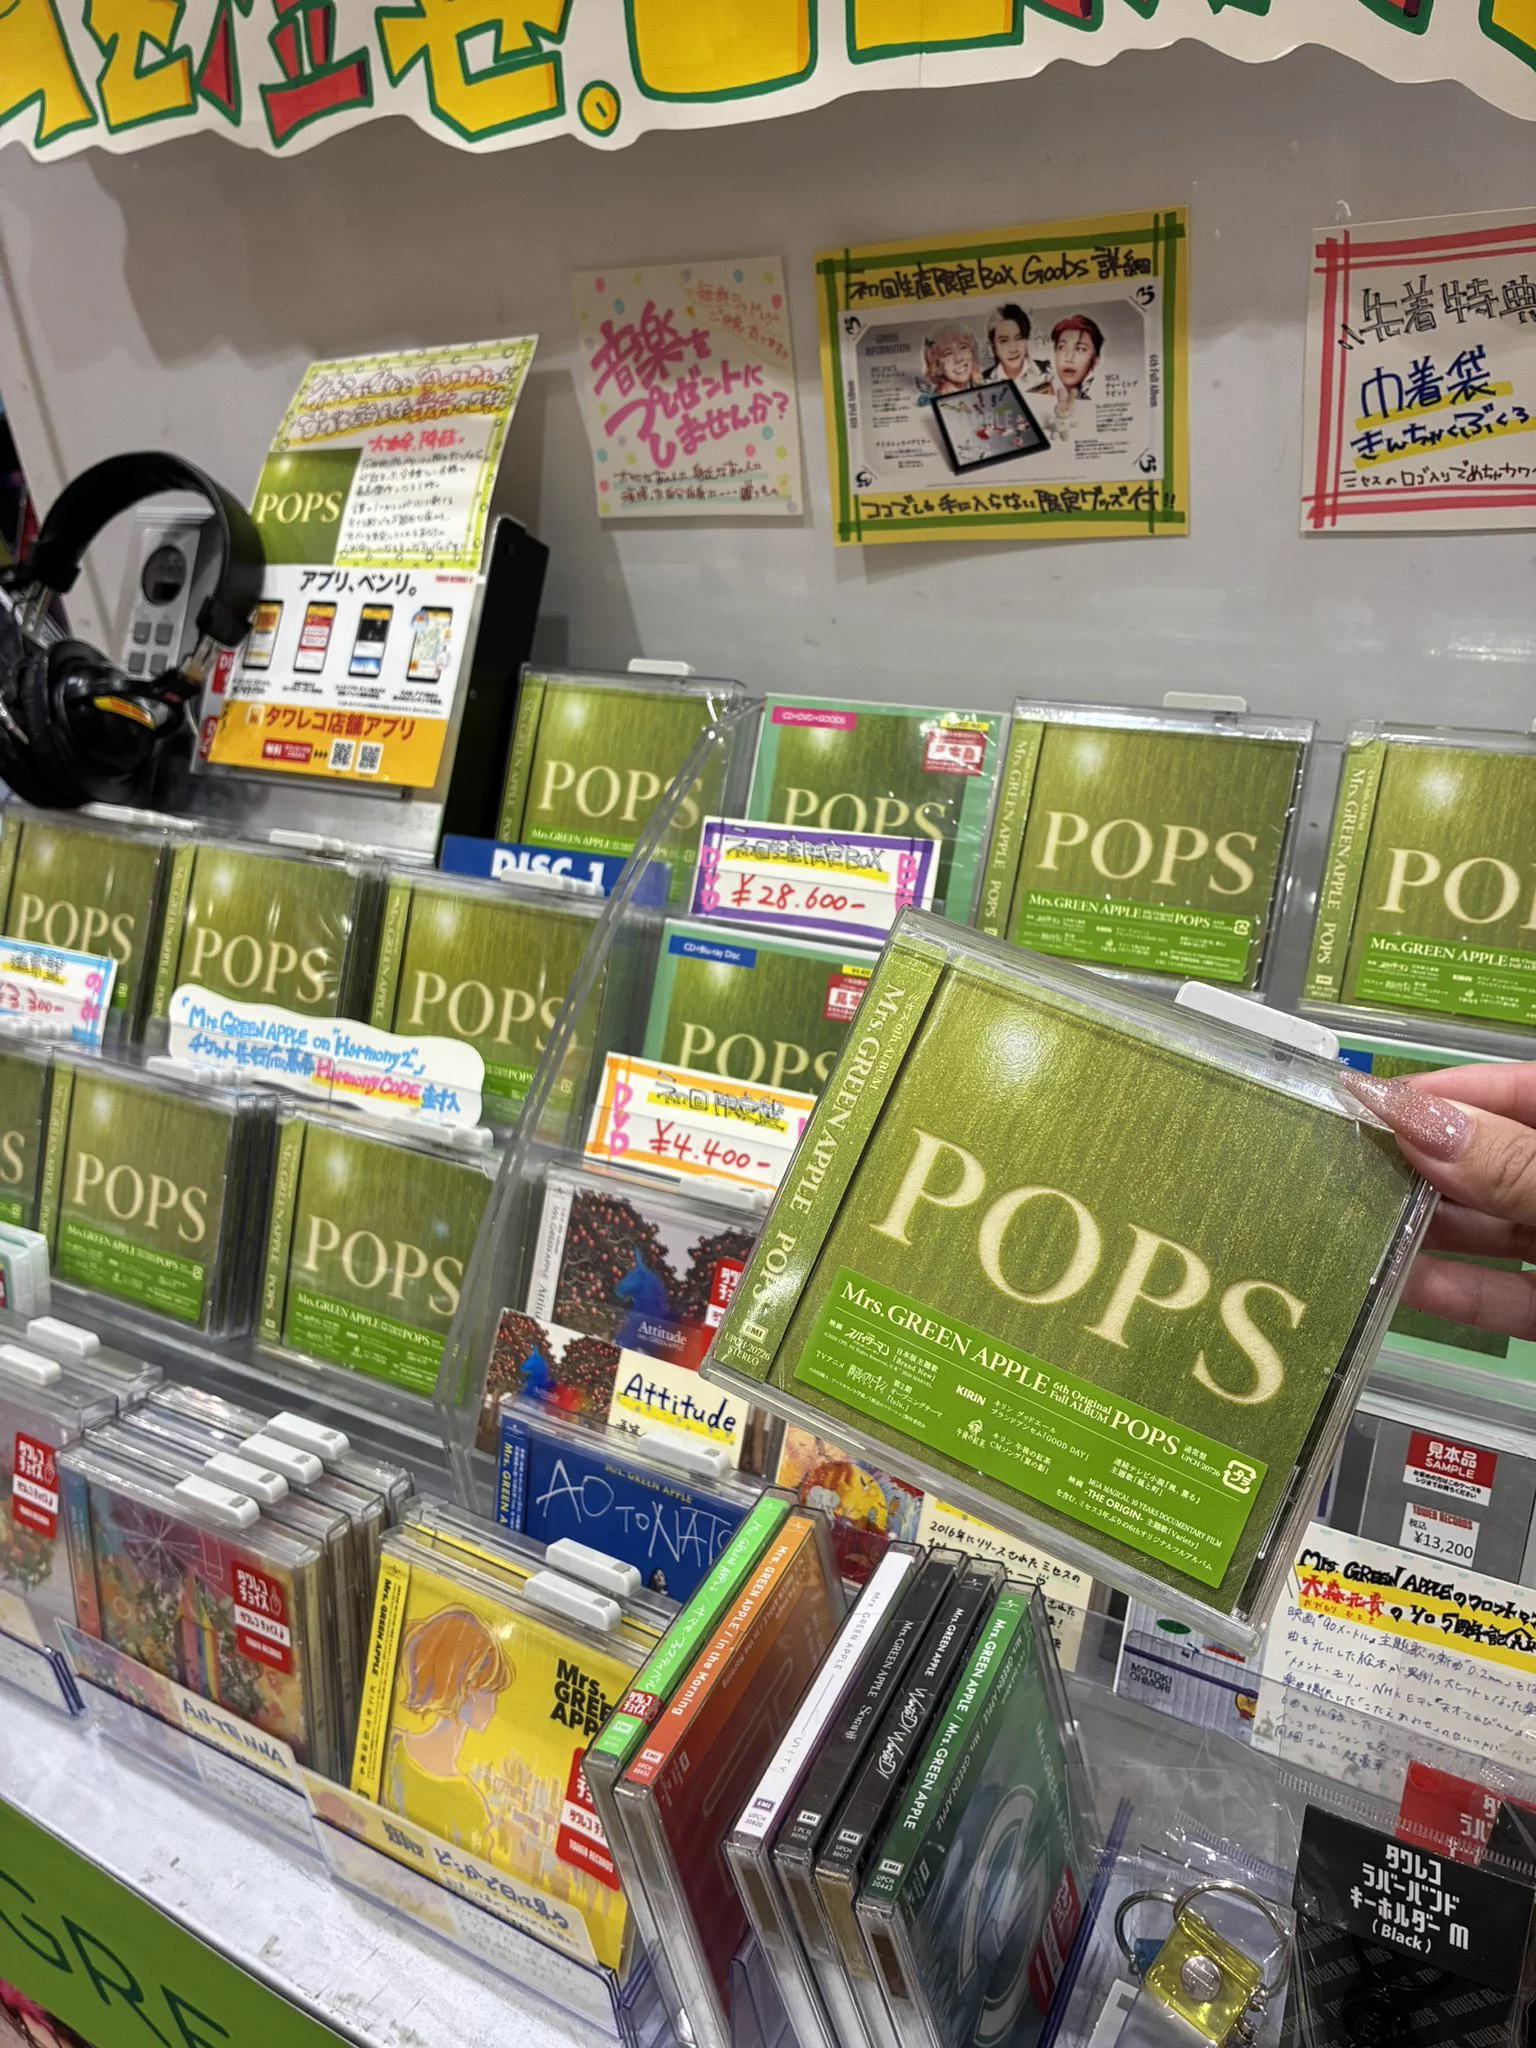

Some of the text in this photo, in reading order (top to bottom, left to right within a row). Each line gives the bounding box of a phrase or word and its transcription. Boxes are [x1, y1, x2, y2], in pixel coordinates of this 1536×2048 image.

[845, 262, 977, 301] 初回生産限定
[1021, 252, 1089, 287] Goods
[1359, 273, 1536, 343] 先着特典
[590, 299, 712, 397] 音楽を
[604, 360, 764, 441] プレゼントに
[1361, 344, 1497, 419] 巾着袋
[255, 490, 343, 525] POPS
[299, 569, 418, 597] アプリ、ベンリ。
[265, 704, 417, 740] タワレコ店舗アプリ
[538, 758, 704, 830] POPS
[783, 786, 949, 841] POPS
[1036, 810, 1259, 896] POPS
[985, 880, 1002, 919] POPS
[1377, 846, 1536, 932] PO
[15, 893, 135, 966] POPS
[1100, 902, 1212, 930] APPLE POPS
[1316, 921, 1337, 965] POPS
[1457, 949, 1509, 968] APPLE
[189, 926, 329, 1003] POPS
[410, 970, 579, 1058] POPS
[827, 1036, 880, 1131] GREEN
[790, 1129, 839, 1216] APPLE
[72, 1151, 209, 1244] POPS
[304, 1213, 464, 1318] POPS
[752, 1229, 798, 1303] POPS
[869, 1127, 1307, 1406] POPS
[401, 1326, 432, 1348] POPS
[636, 1319, 689, 1348] Attitude
[743, 1323, 765, 1341] EMI
[728, 1345, 760, 1367] STEREO
[970, 1346, 1051, 1395] APPLE
[621, 1371, 737, 1435] Attitude
[955, 1384, 987, 1407] KIRIN
[1049, 1389, 1110, 1425] Full ALBUM
[1053, 1381, 1113, 1415] 6th Original
[1109, 1408, 1181, 1457] POPS
[1424, 1457, 1477, 1480] SAMPLE
[1425, 1440, 1478, 1469] 見本品
[627, 1470, 693, 1505] GREEN APPLE
[1138, 1499, 1160, 1518] YEARS
[1158, 1506, 1207, 1541] DOCUMENTARY
[1205, 1531, 1223, 1549] FILM
[1408, 1517, 1427, 1531] 税込
[1412, 1503, 1473, 1531] TOWER RECORDS
[768, 1543, 787, 1566] Mrs.
[1413, 1530, 1474, 1560] ¥13,200
[236, 1567, 269, 1596] タワレコ
[746, 1563, 774, 1599] GREEN
[1297, 1548, 1407, 1588] Mrs. GREEN
[377, 1605, 389, 1642] GREEN
[727, 1597, 753, 1631] APPLE
[371, 1643, 383, 1676] APPLE
[701, 1648, 721, 1671] the
[924, 1652, 943, 1678] APPLE
[1130, 1661, 1173, 1686] MOTOKI
[556, 1658, 607, 1701] Mrs.
[670, 1667, 708, 1718] Morning
[866, 1669, 888, 1699] APPLE
[1129, 1672, 1172, 1695] OHMORI
[549, 1699, 602, 1738] APP
[554, 1680, 617, 1724] GREE
[903, 1618, 1008, 1831] Mrs. GREEN APPLE Mrs. GREEN APPLE
[568, 1838, 614, 1874] TOWER RECORDS
[882, 1863, 899, 1872] EMI
[1385, 1844, 1442, 1884] タワレコ
[1349, 1885, 1441, 1932] キーホルダー
[1360, 1862, 1460, 1917] ラバーバンド
